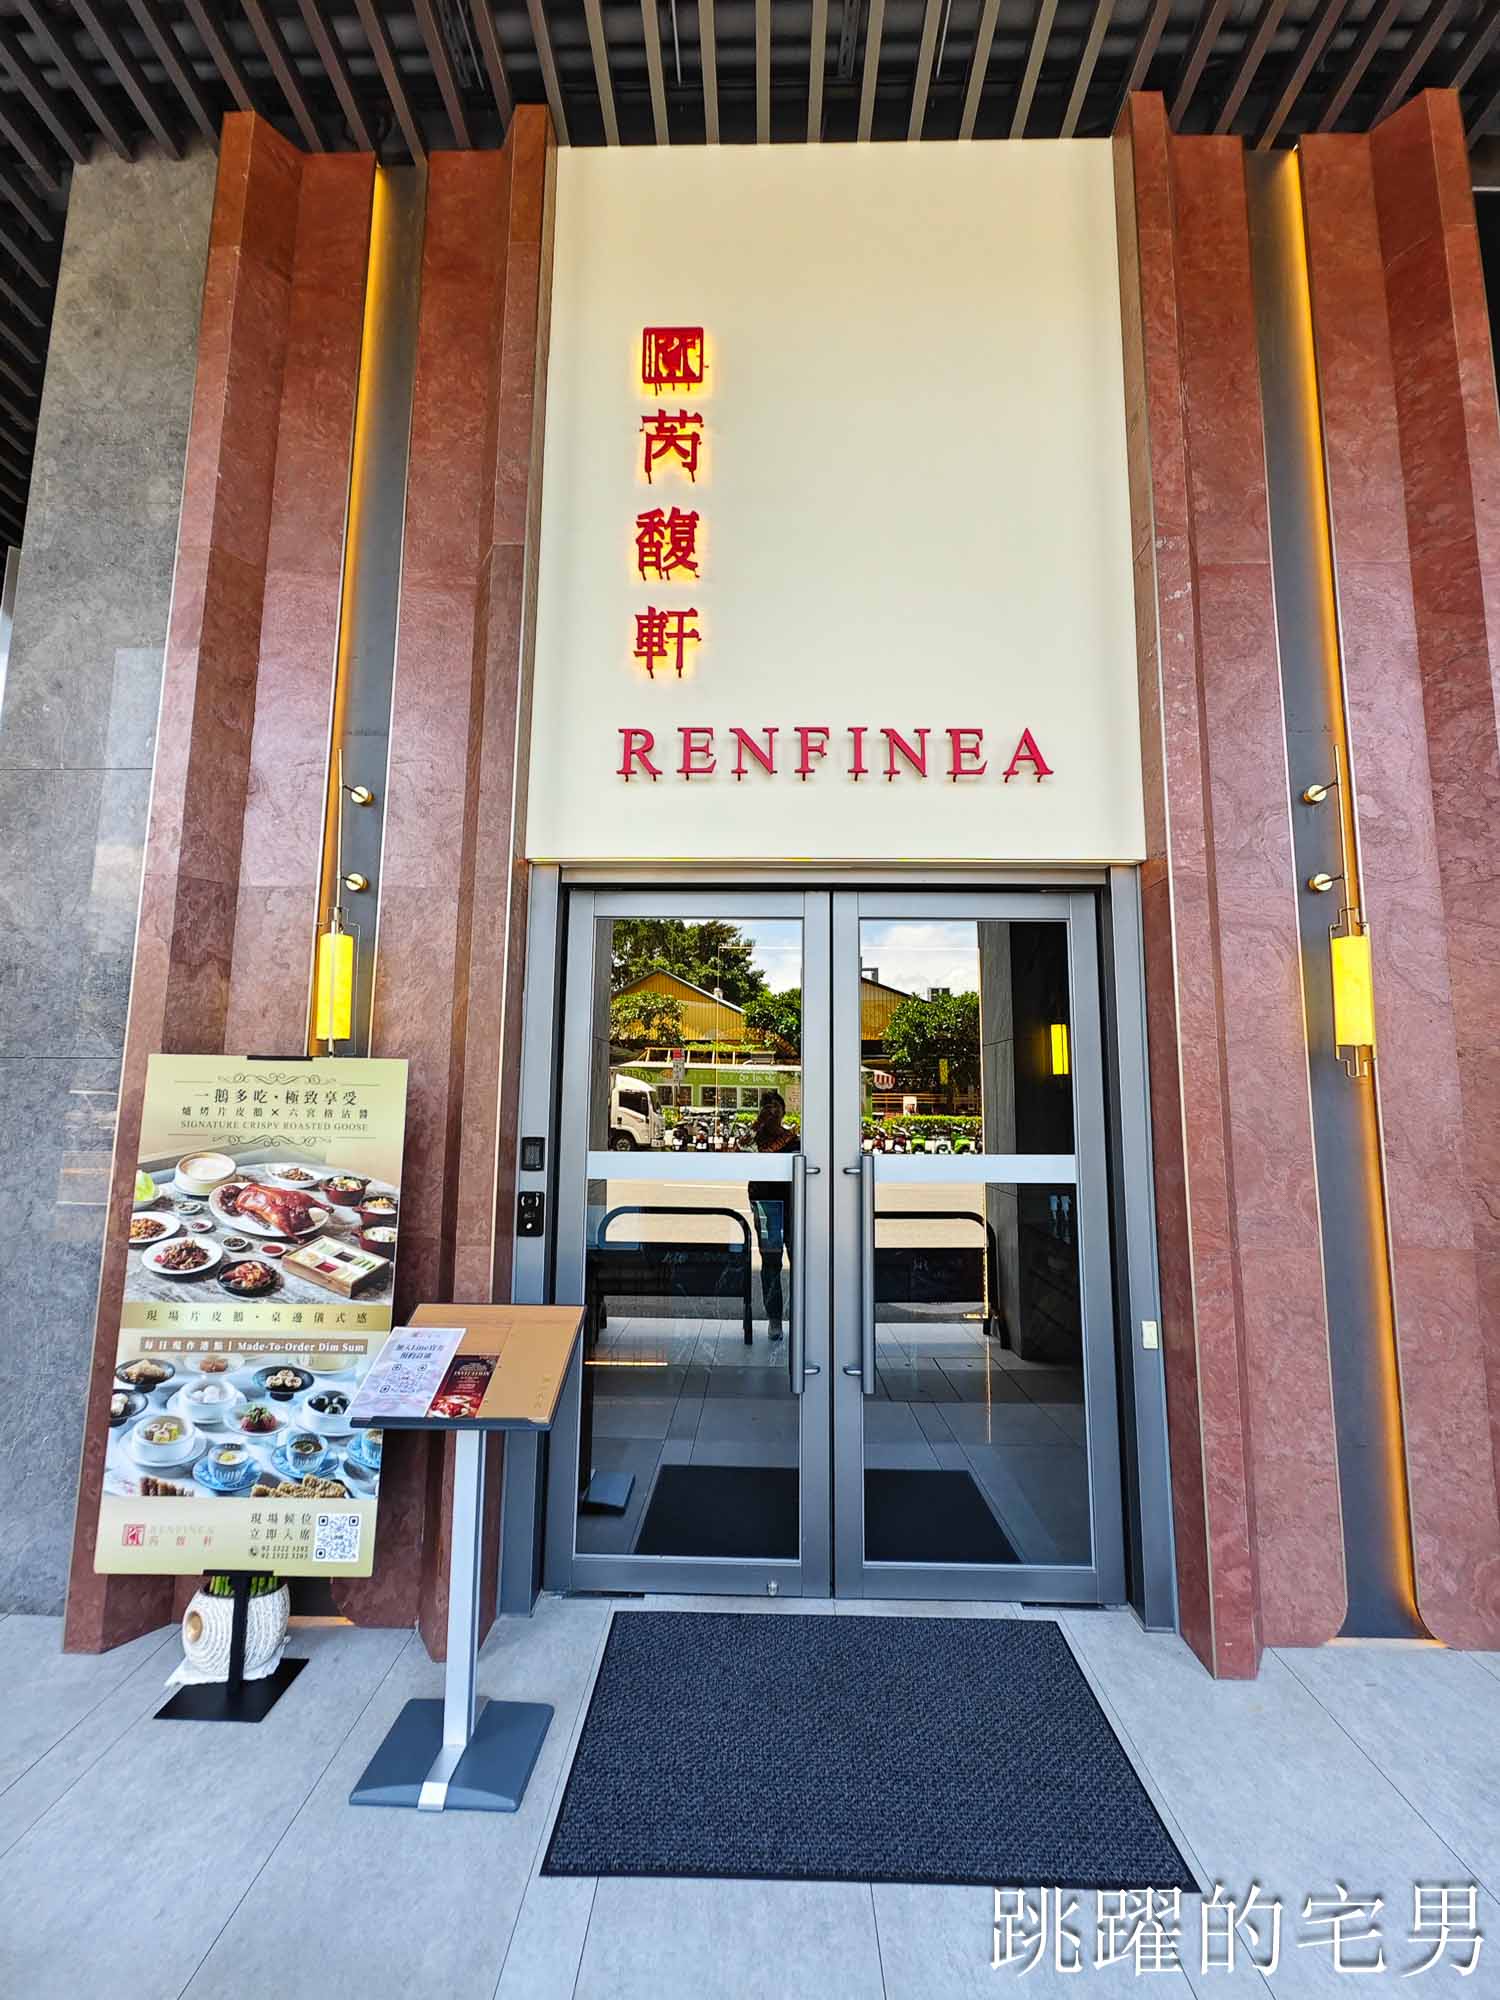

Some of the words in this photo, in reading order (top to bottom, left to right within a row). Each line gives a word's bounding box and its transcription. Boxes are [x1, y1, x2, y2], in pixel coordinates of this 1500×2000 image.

[634, 408, 703, 678] 芮馥軒
[616, 727, 1054, 781] RENFINEA
[180, 1120, 239, 1129] SIGNATURE
[242, 1121, 279, 1129] CRISPY
[283, 1122, 331, 1130] ROASTED
[334, 1123, 368, 1132] GOOSE
[238, 1341, 315, 1352] Made-To-Order
[318, 1342, 339, 1352] Dim
[342, 1343, 365, 1353] Sum
